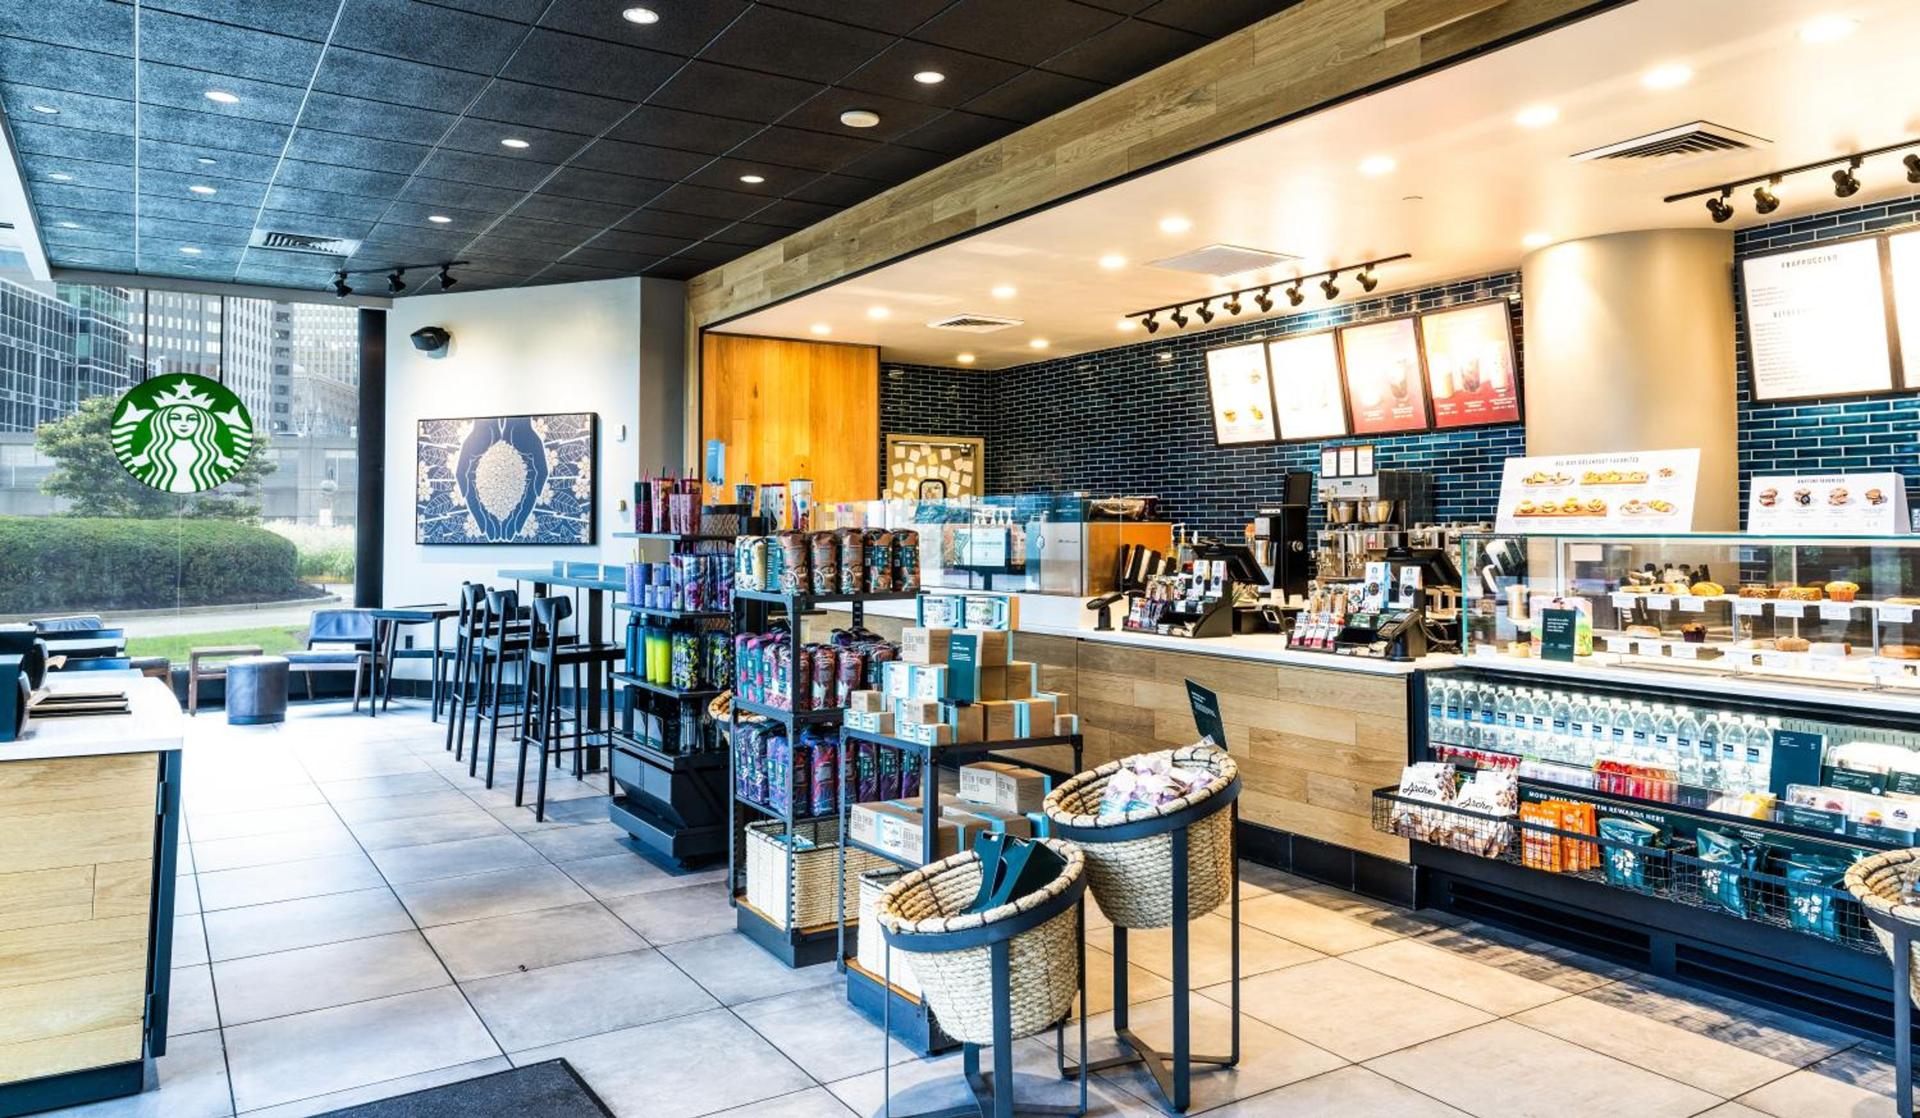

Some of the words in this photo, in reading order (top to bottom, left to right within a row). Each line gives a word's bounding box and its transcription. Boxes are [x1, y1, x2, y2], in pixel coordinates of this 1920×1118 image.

[1402, 782, 1437, 798] Archer
[1458, 797, 1494, 813] Archer
[1528, 790, 1548, 800] MORE
[1608, 805, 1645, 819] REWARDS
[1645, 813, 1665, 823] HERE
